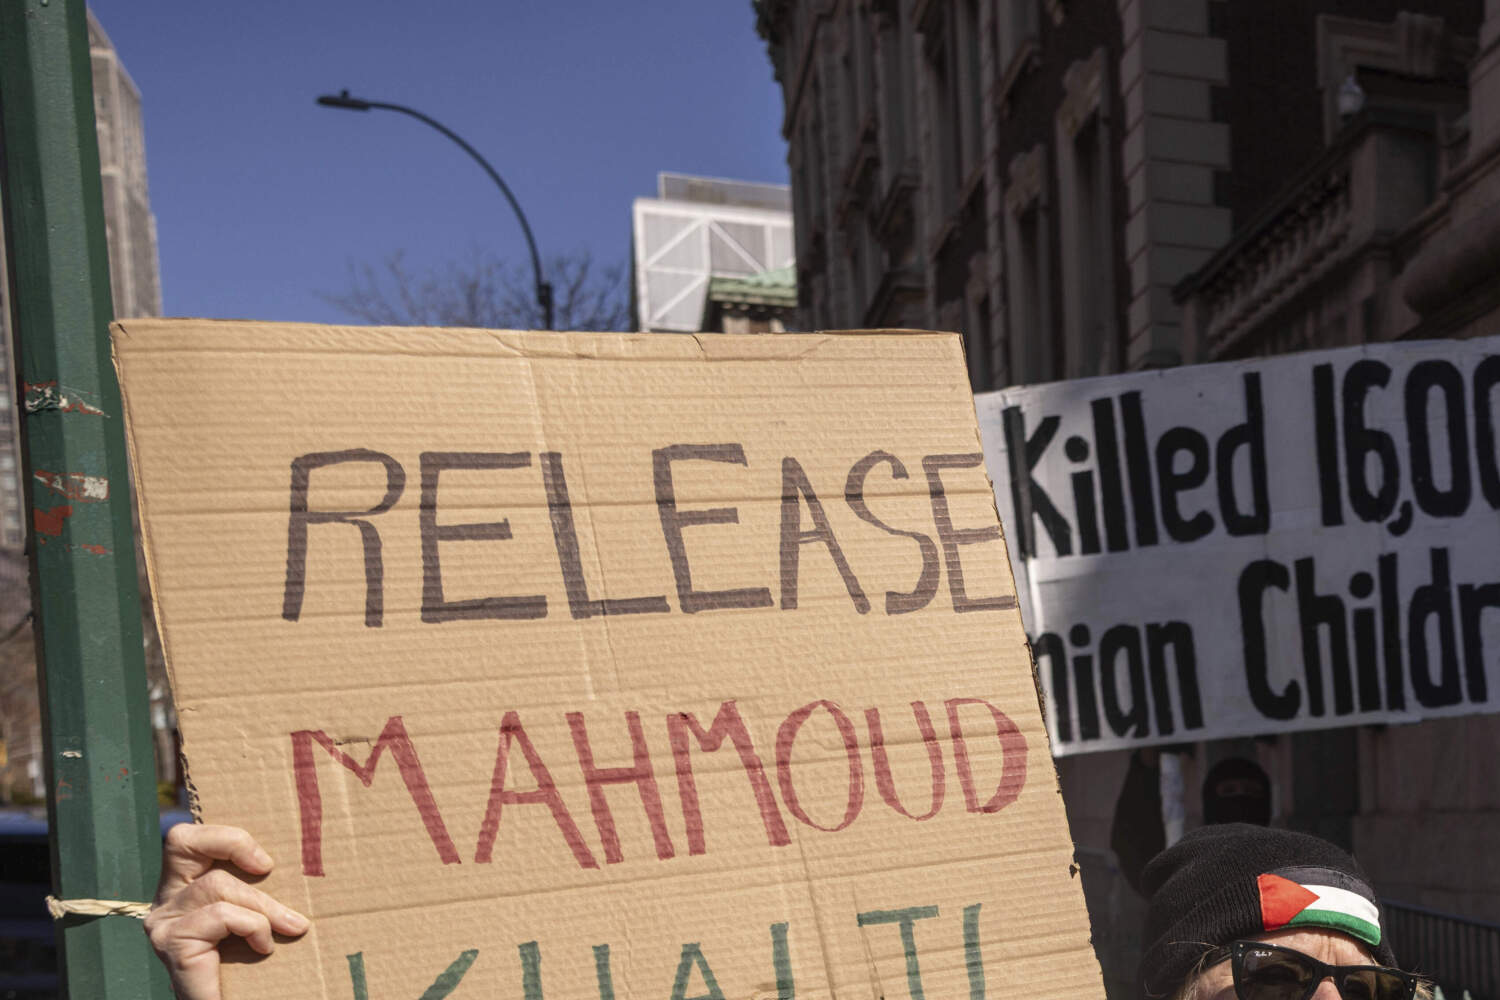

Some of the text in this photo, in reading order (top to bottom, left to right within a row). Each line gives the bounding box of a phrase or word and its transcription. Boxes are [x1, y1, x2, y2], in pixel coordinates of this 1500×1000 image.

[281, 443, 1015, 627] RELEASE
[1002, 371, 1272, 561] Killed
[290, 697, 1028, 878] MAHMOUD
